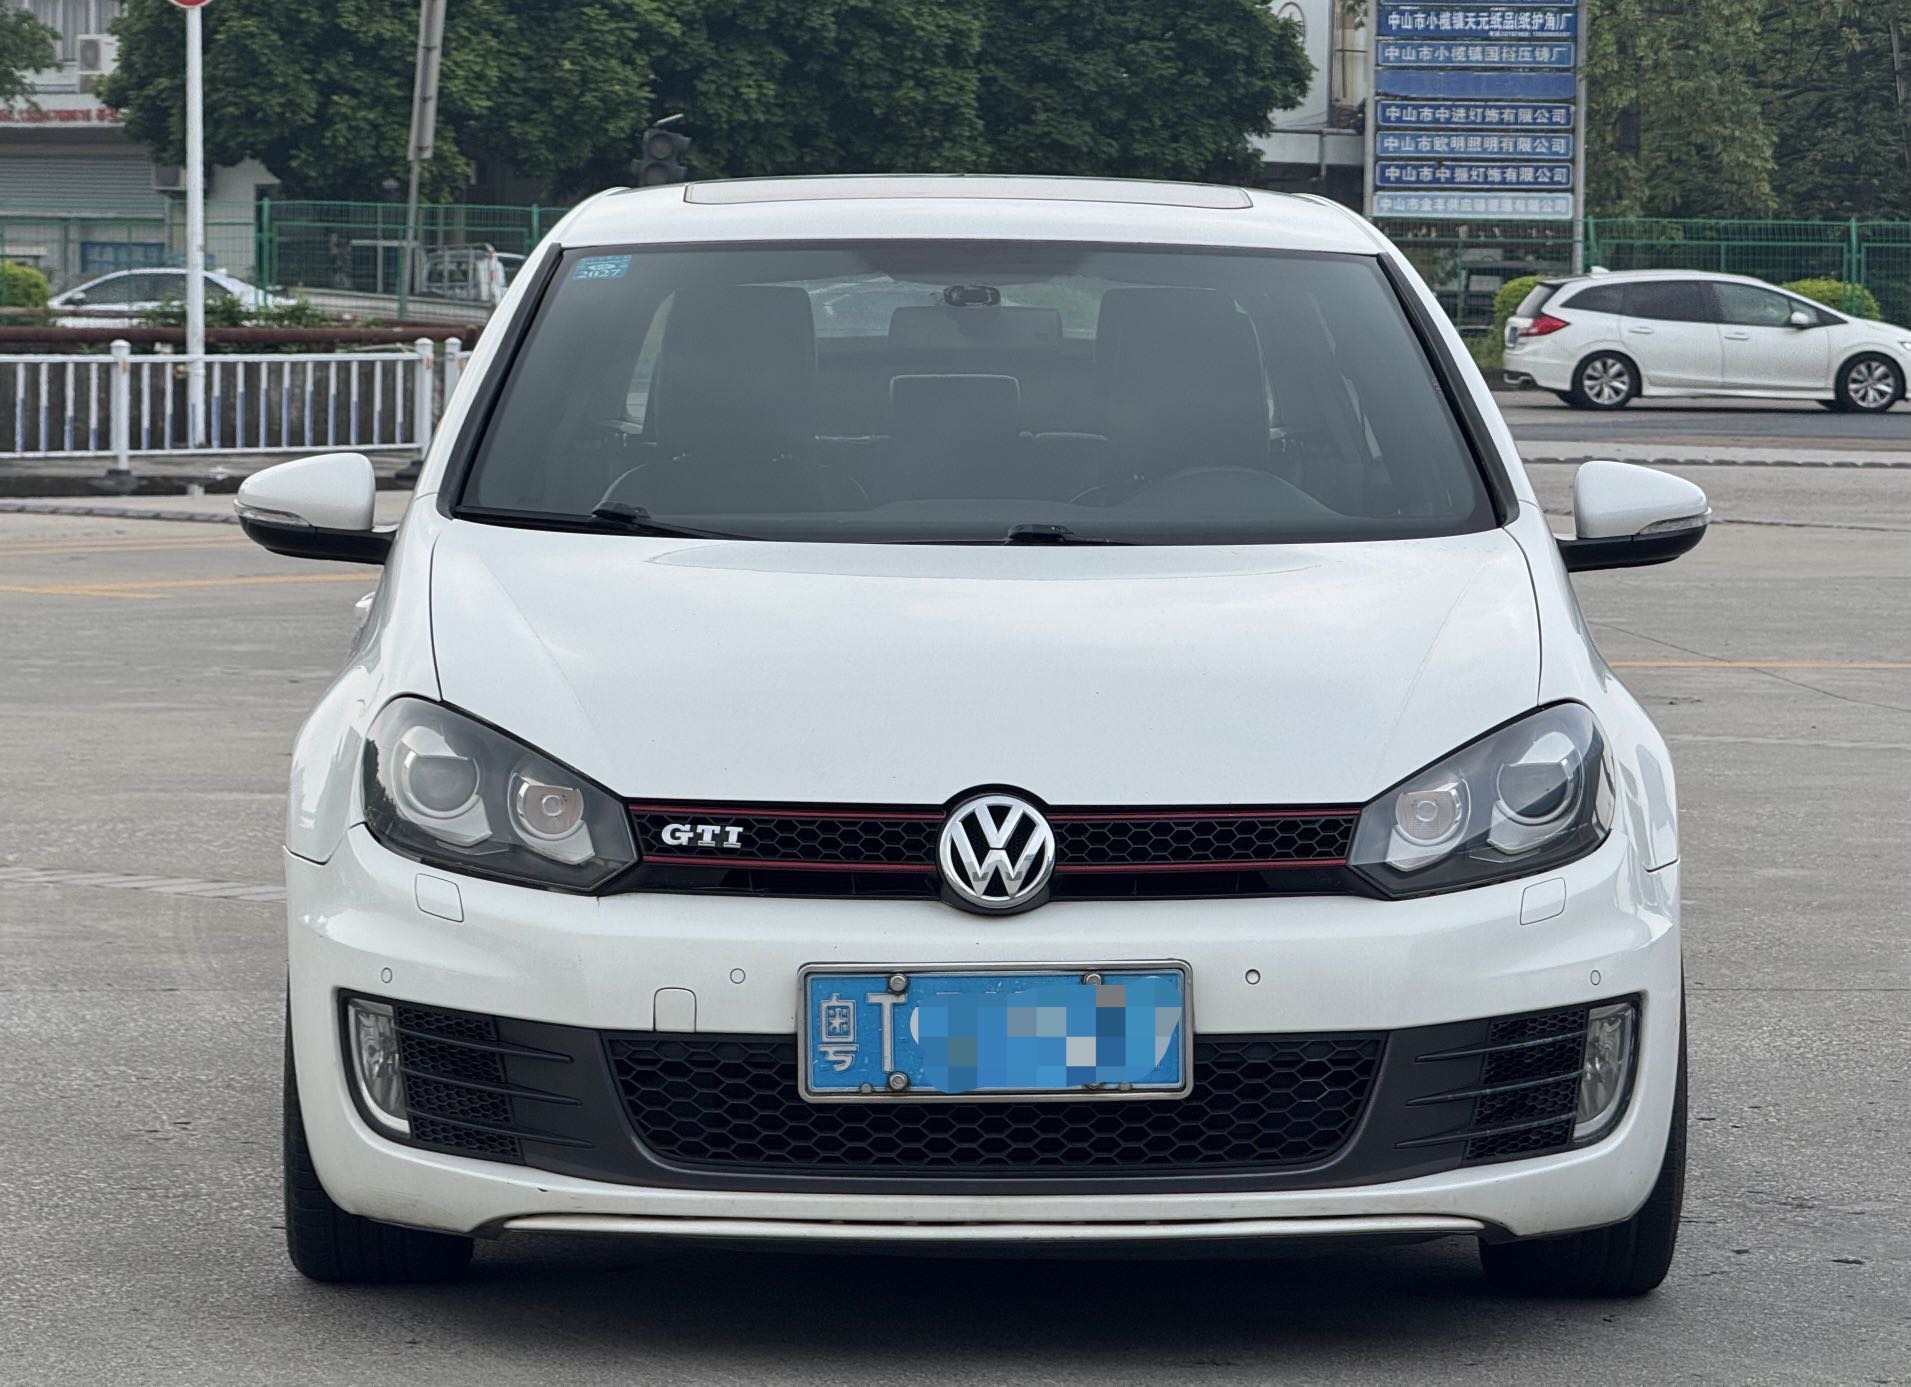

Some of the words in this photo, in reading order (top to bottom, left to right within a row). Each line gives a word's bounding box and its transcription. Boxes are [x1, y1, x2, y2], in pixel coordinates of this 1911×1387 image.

[1385, 106, 1567, 124] 中山市中进灯饰有限公司
[1383, 136, 1566, 153] 中山市欧明照明有限公司
[661, 822, 744, 849] GTI
